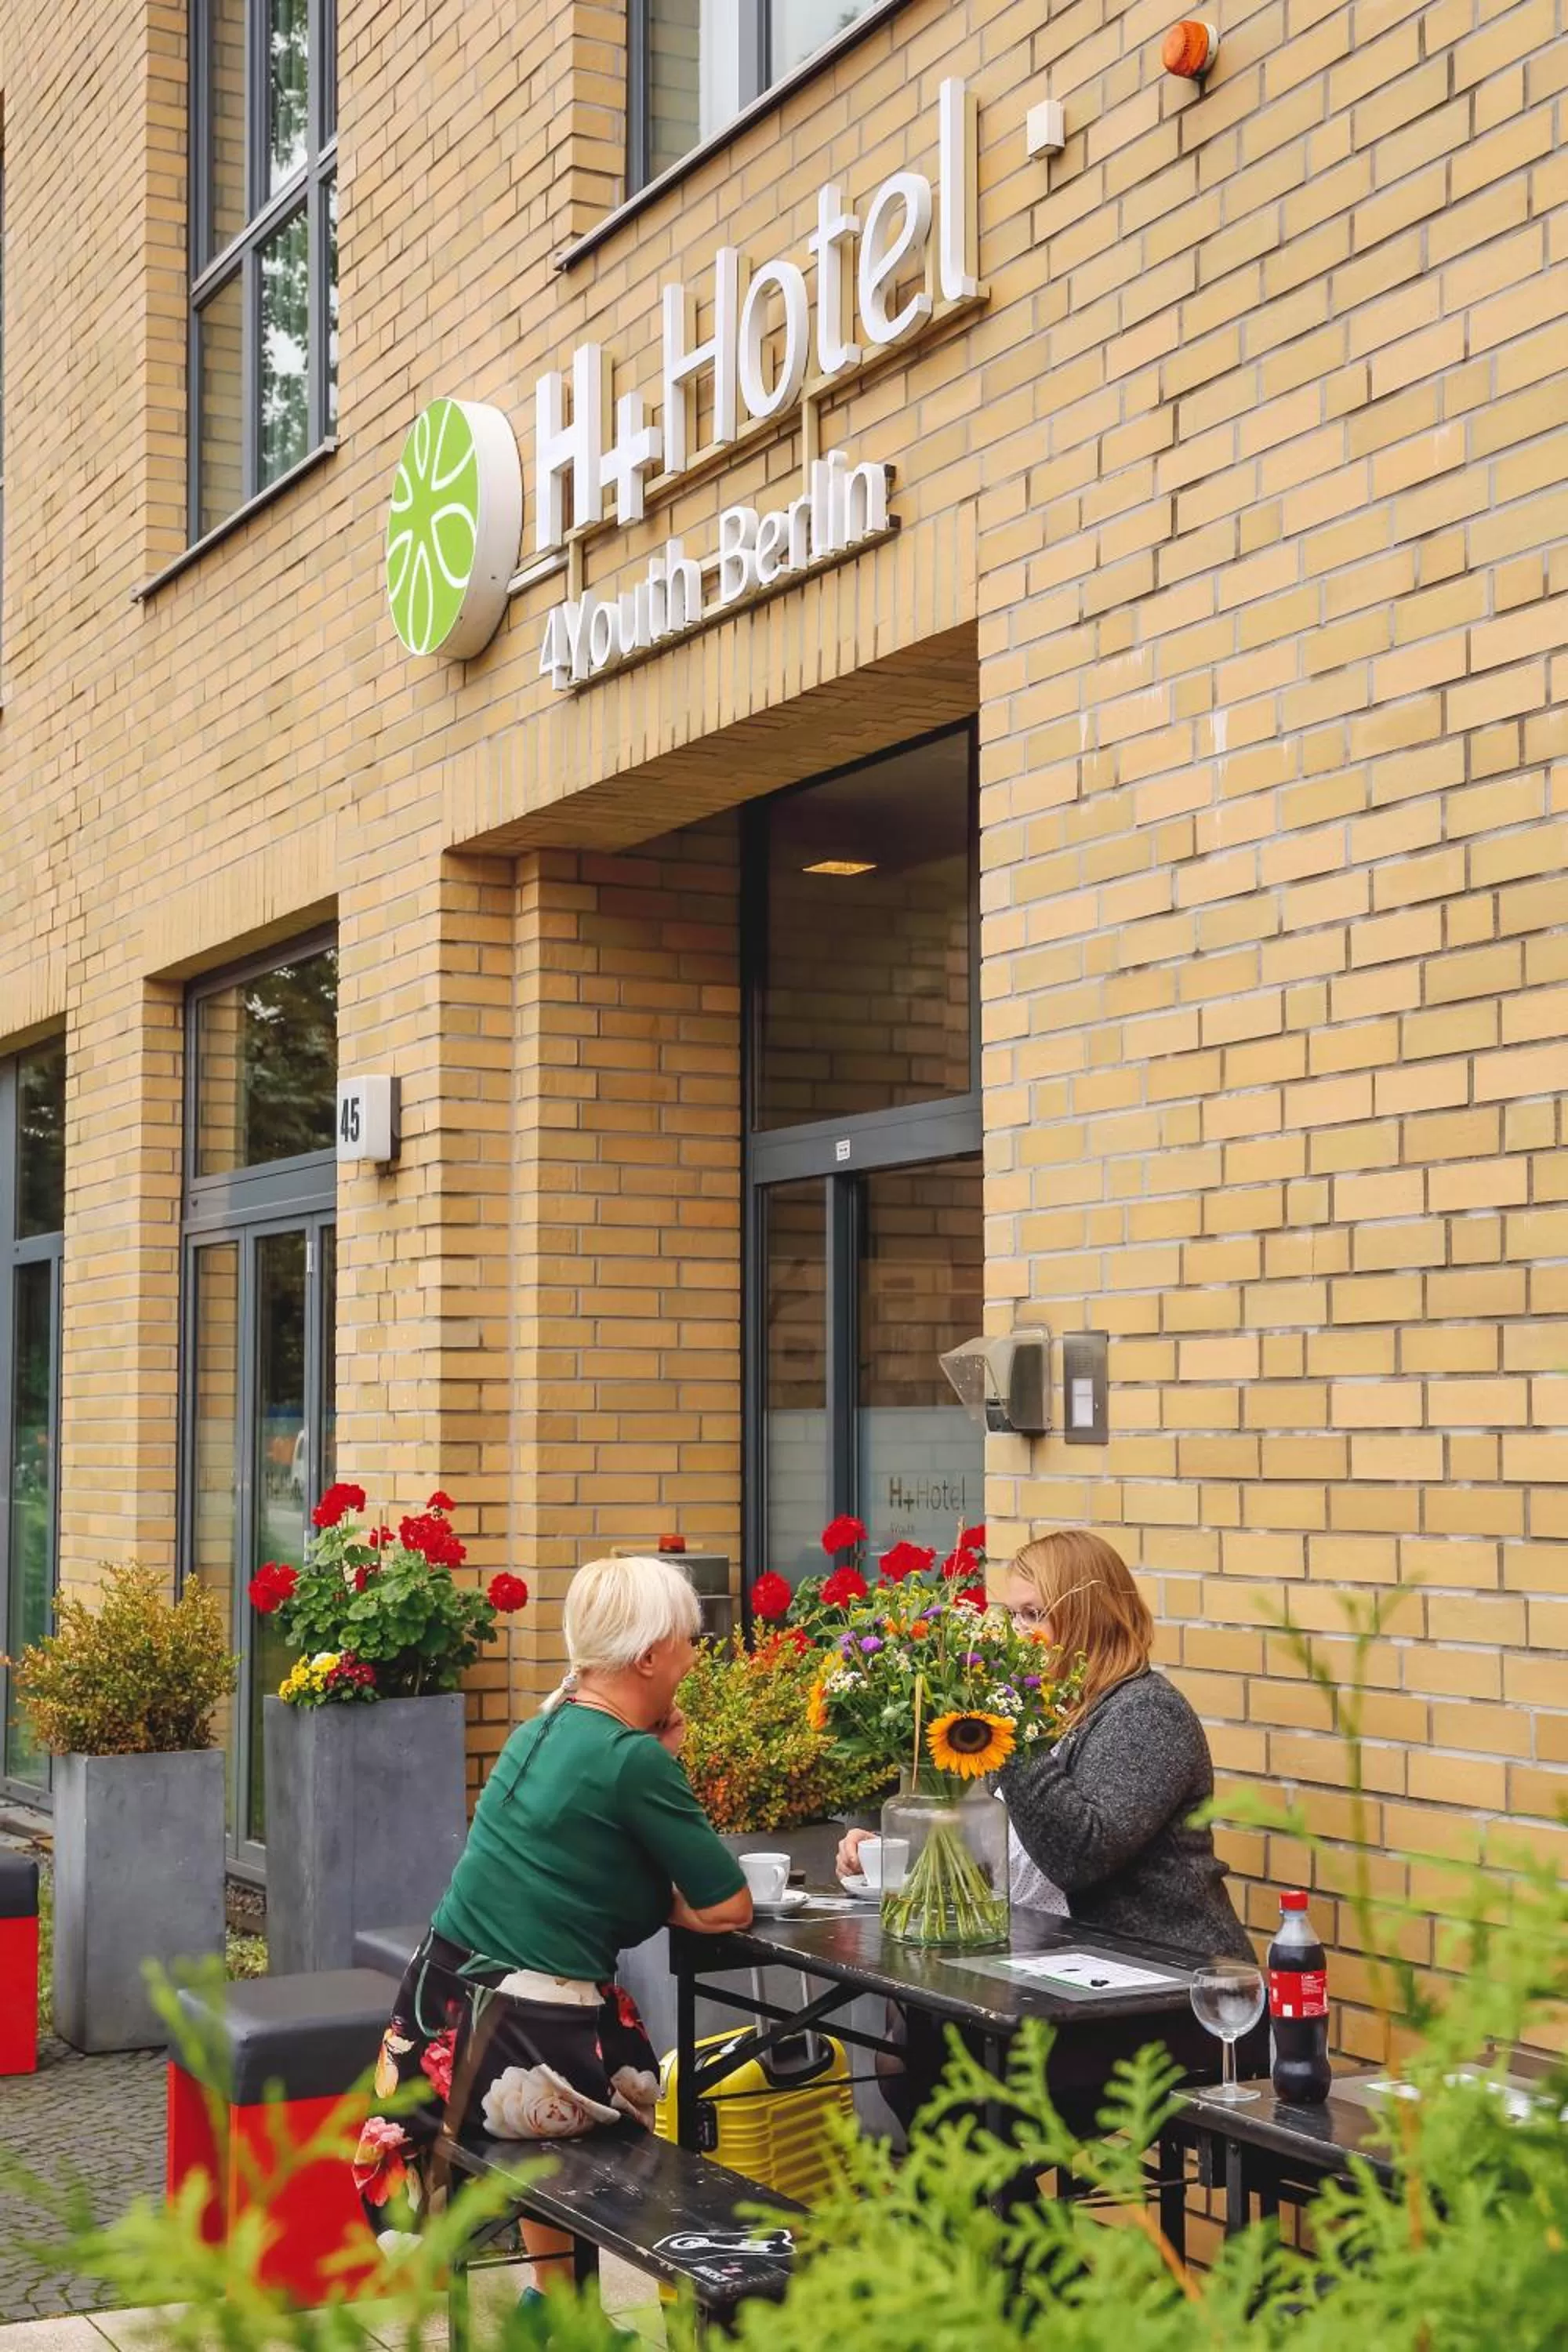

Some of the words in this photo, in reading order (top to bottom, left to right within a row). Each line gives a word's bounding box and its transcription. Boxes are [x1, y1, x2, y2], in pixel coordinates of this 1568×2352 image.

[539, 539, 702, 691] 4Youth
[720, 449, 887, 605] Berlin
[340, 1097, 360, 1142] 45
